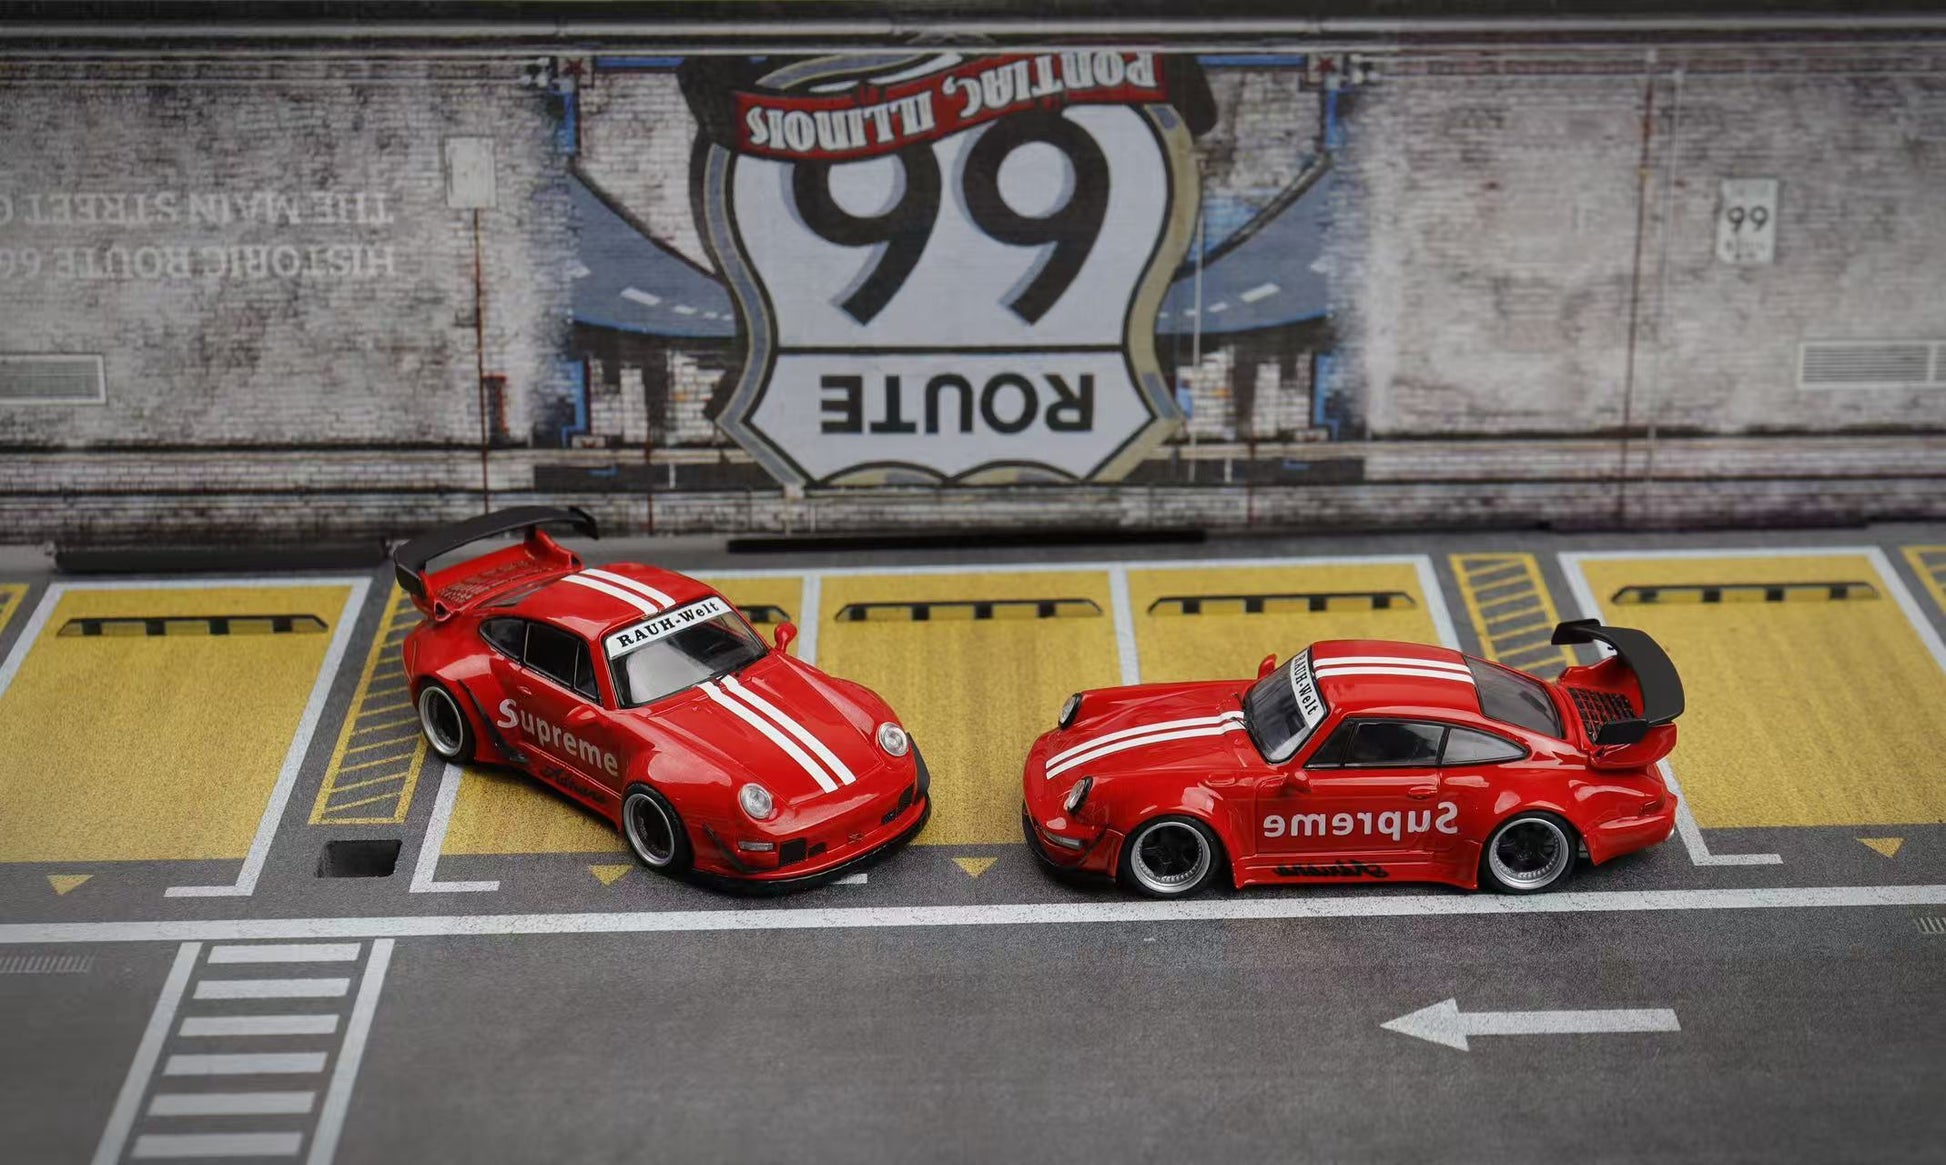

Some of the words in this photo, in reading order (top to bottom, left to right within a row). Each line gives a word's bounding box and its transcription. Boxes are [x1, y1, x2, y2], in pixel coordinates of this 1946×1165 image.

[941, 52, 1158, 119] PONTIAC,
[746, 92, 935, 152] ILLINOIS
[25, 191, 177, 225] STREET
[190, 191, 300, 225] MAIN
[307, 191, 395, 225] THE
[790, 112, 1111, 326] 66
[53, 245, 193, 279] ROUTE
[201, 245, 396, 279] HISTORIC
[819, 373, 1096, 434] ROUTE
[617, 601, 719, 648] RAUH-Welt
[1294, 653, 1319, 715] RAUH-Welt
[496, 698, 619, 778] Supreme
